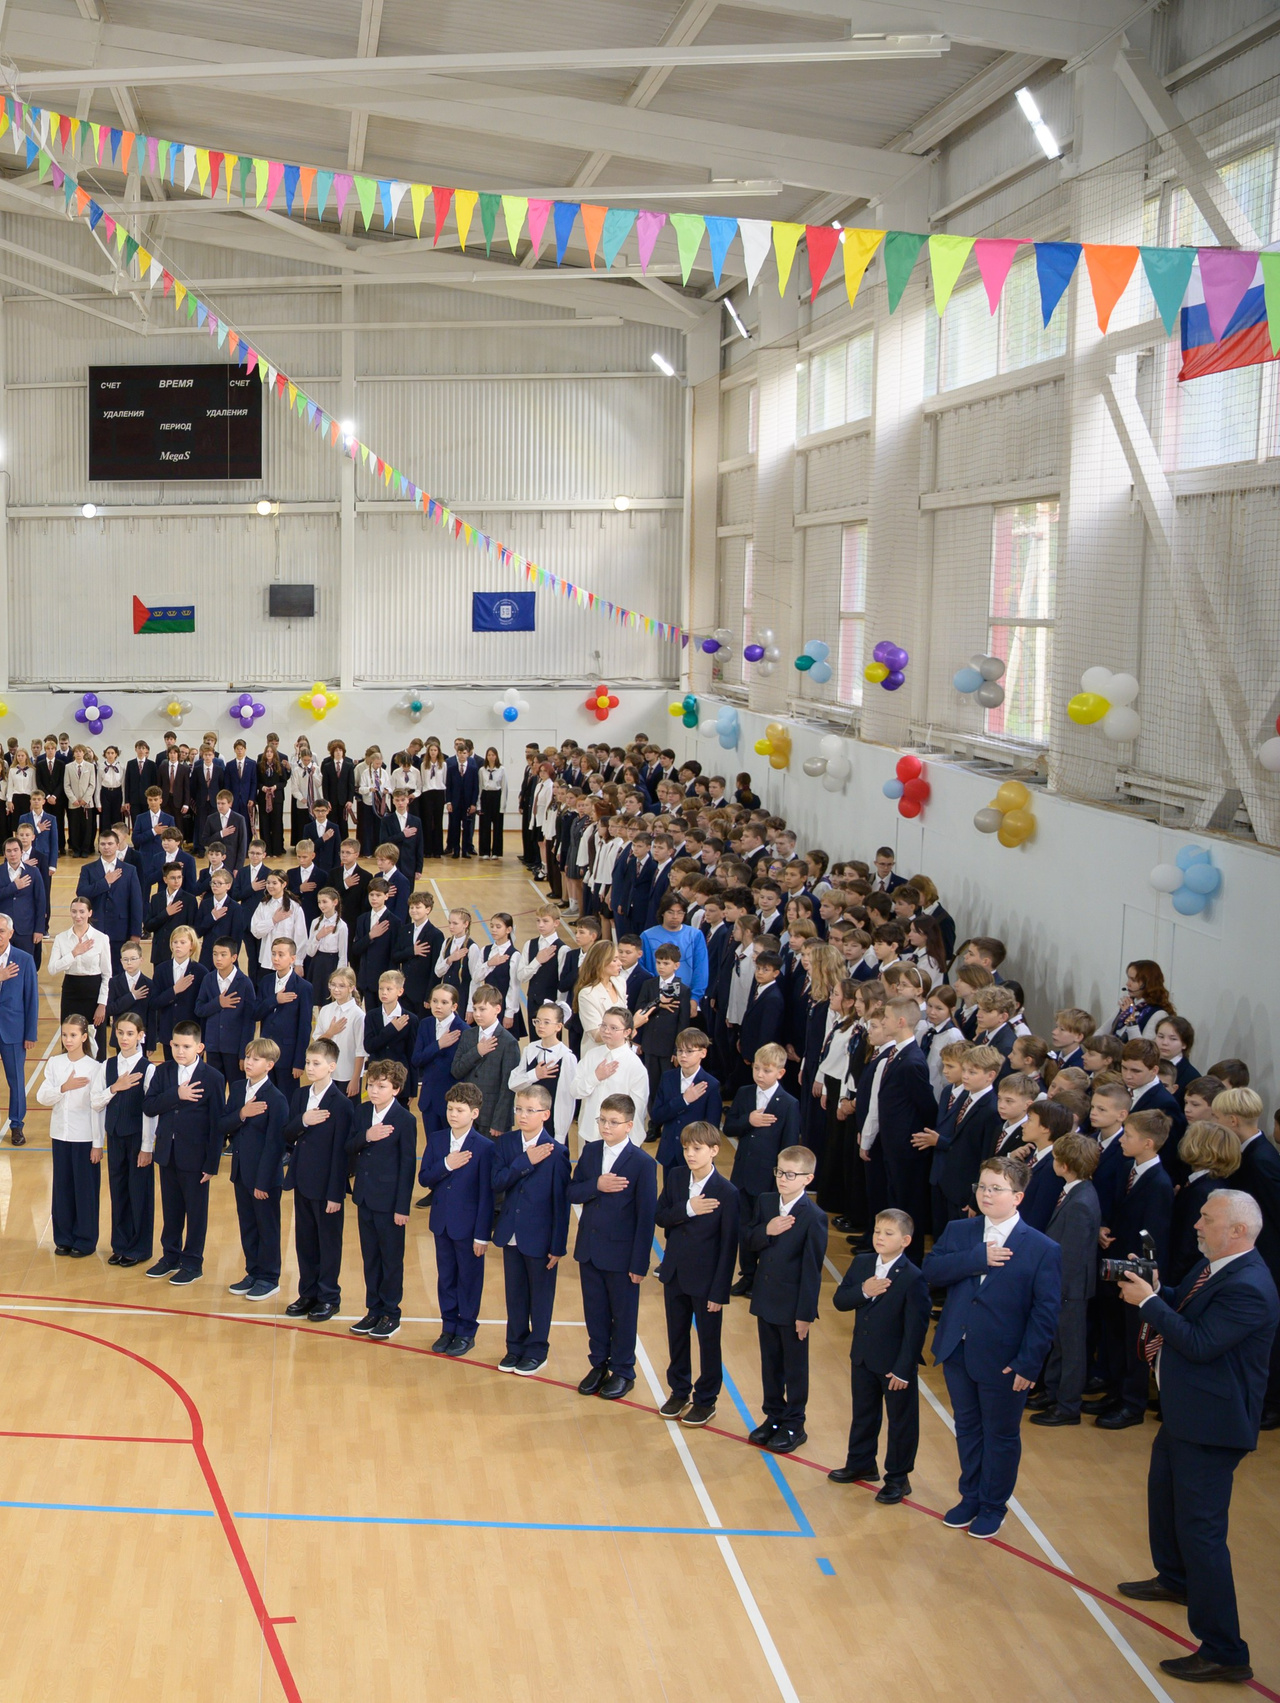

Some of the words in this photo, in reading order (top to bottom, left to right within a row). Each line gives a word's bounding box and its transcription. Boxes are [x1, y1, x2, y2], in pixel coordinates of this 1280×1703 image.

[100, 381, 122, 390] СЧЕТ
[158, 379, 194, 389] ВРЕМЯ
[229, 379, 251, 388] СЧЕТ
[103, 410, 145, 419] УДАЛЕНИЯ
[206, 408, 249, 418] УДАЛЕНИЯ
[159, 423, 192, 432] ПЕРИОД
[159, 450, 191, 463] MegaS
